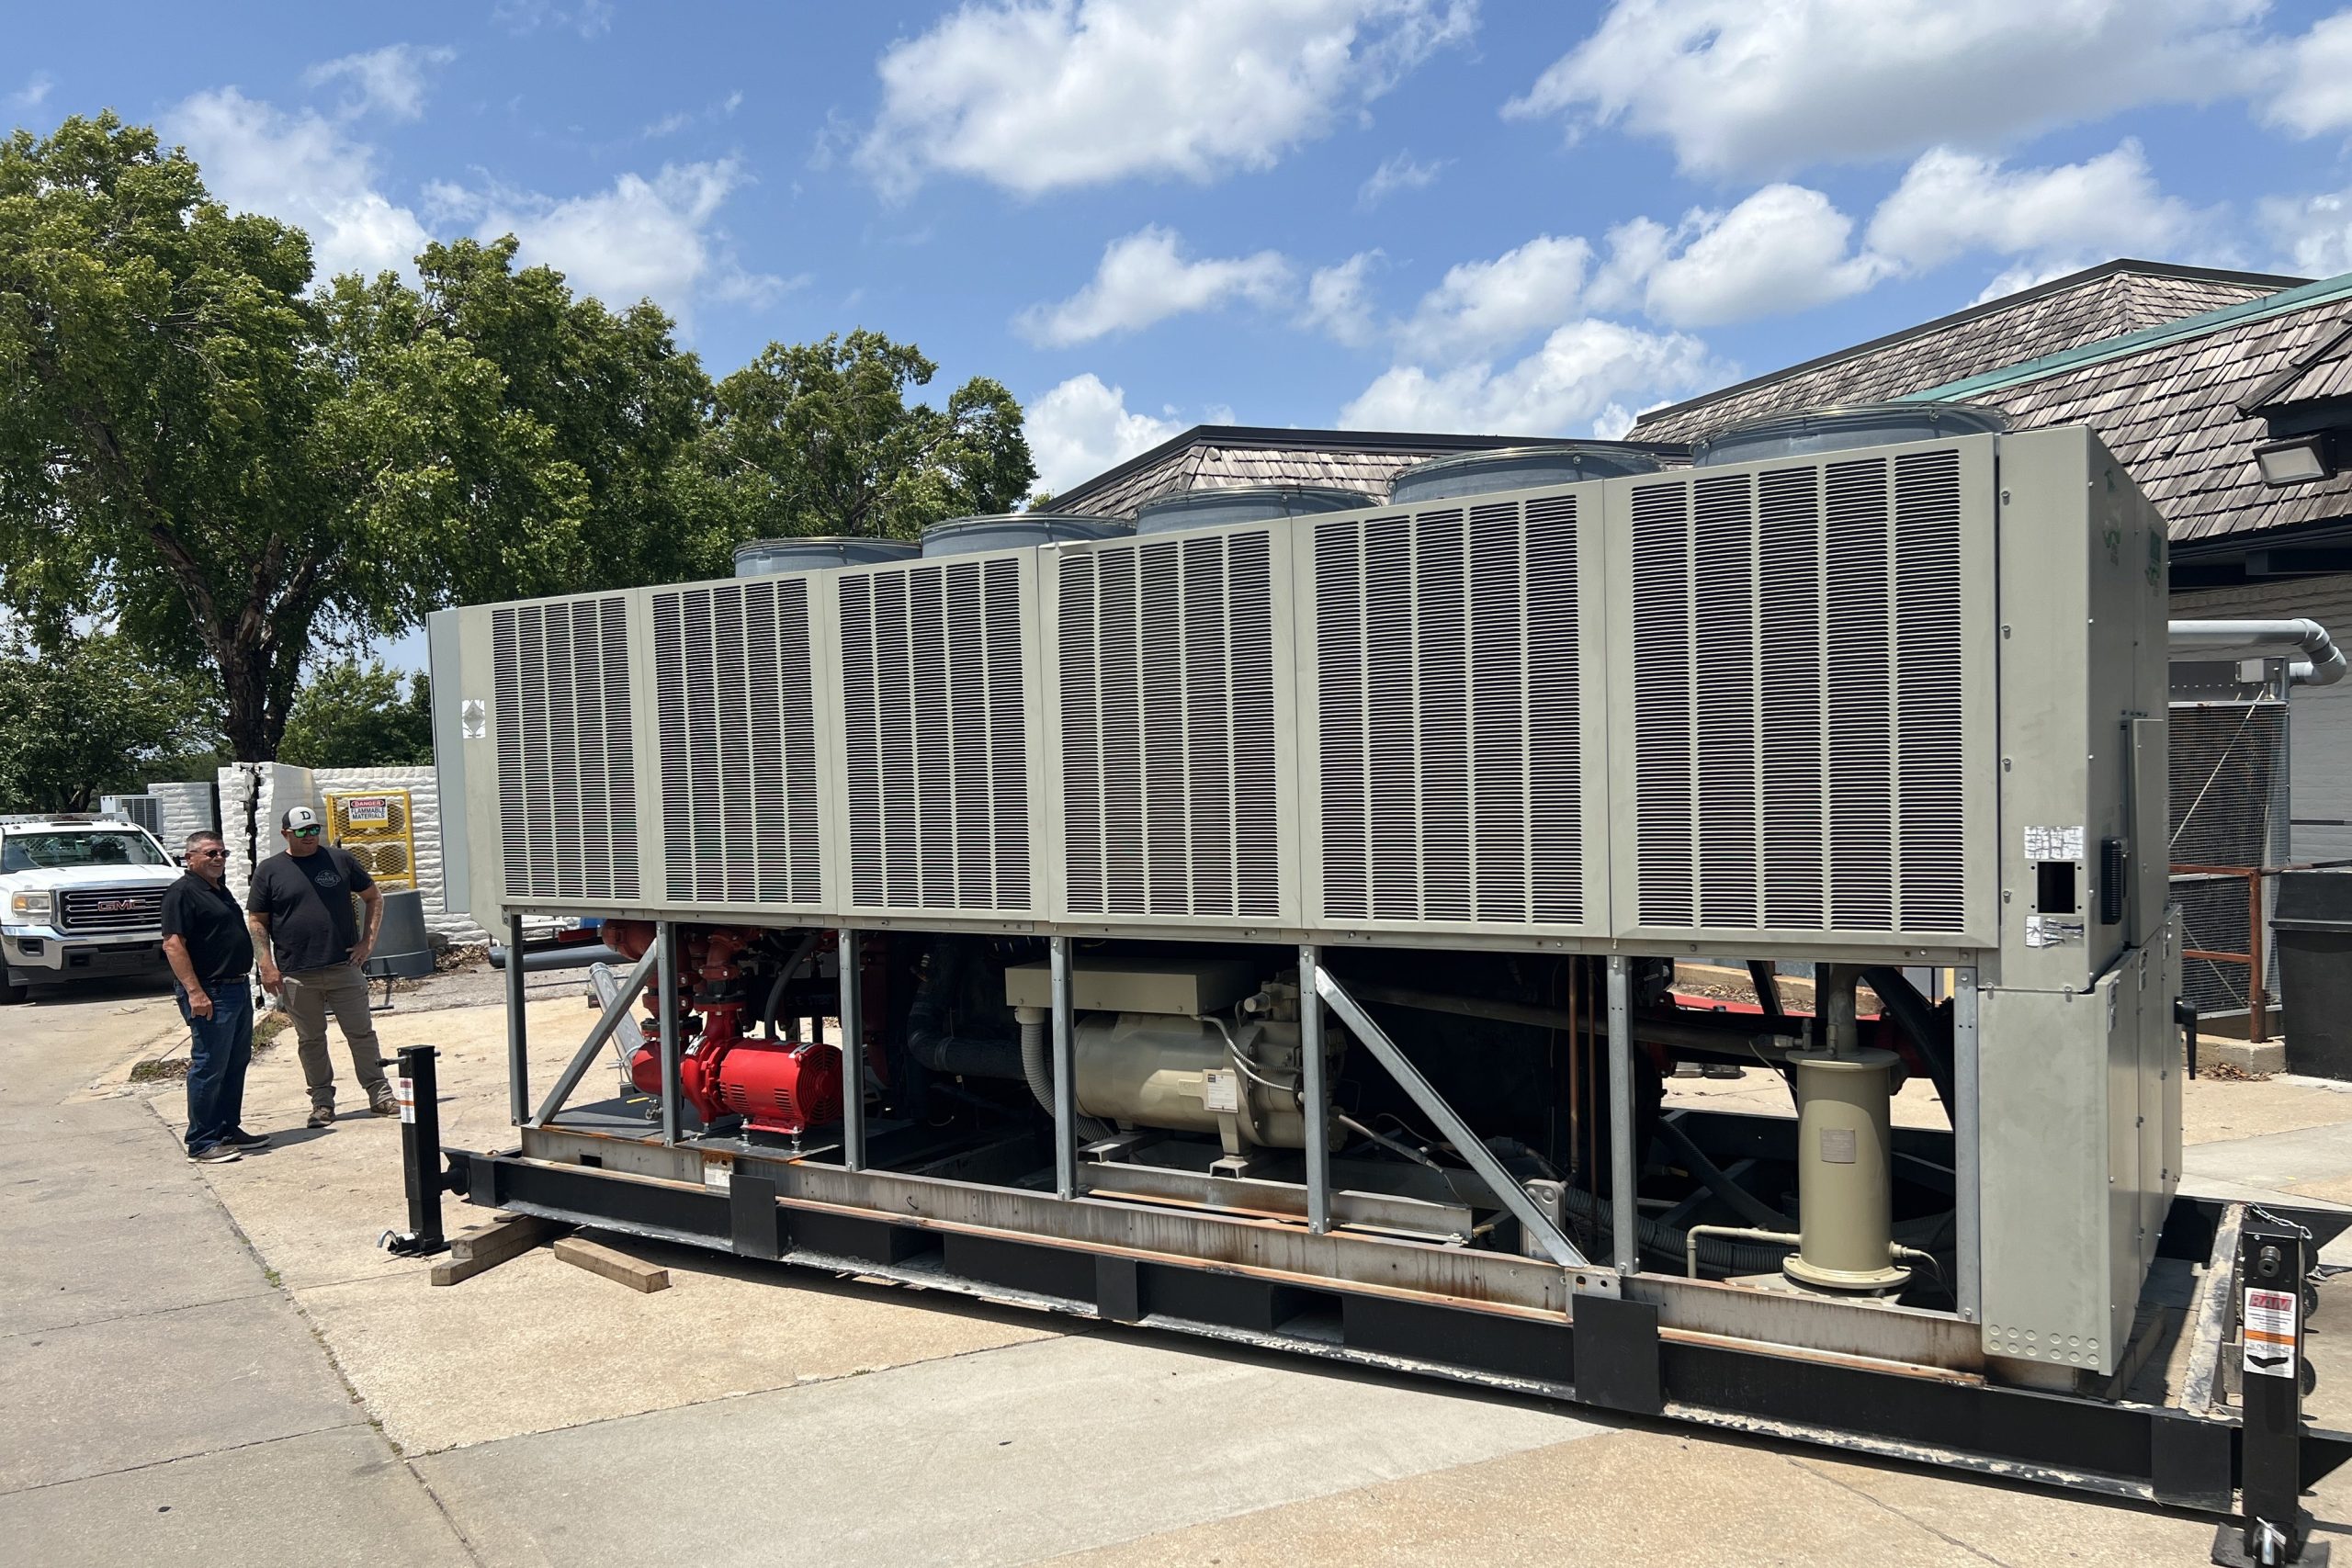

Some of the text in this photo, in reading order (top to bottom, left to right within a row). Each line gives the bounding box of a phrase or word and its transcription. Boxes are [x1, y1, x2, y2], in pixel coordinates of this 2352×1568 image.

[300, 811, 311, 819] D
[97, 899, 146, 911] GMC
[2249, 1294, 2292, 1312] RAM
